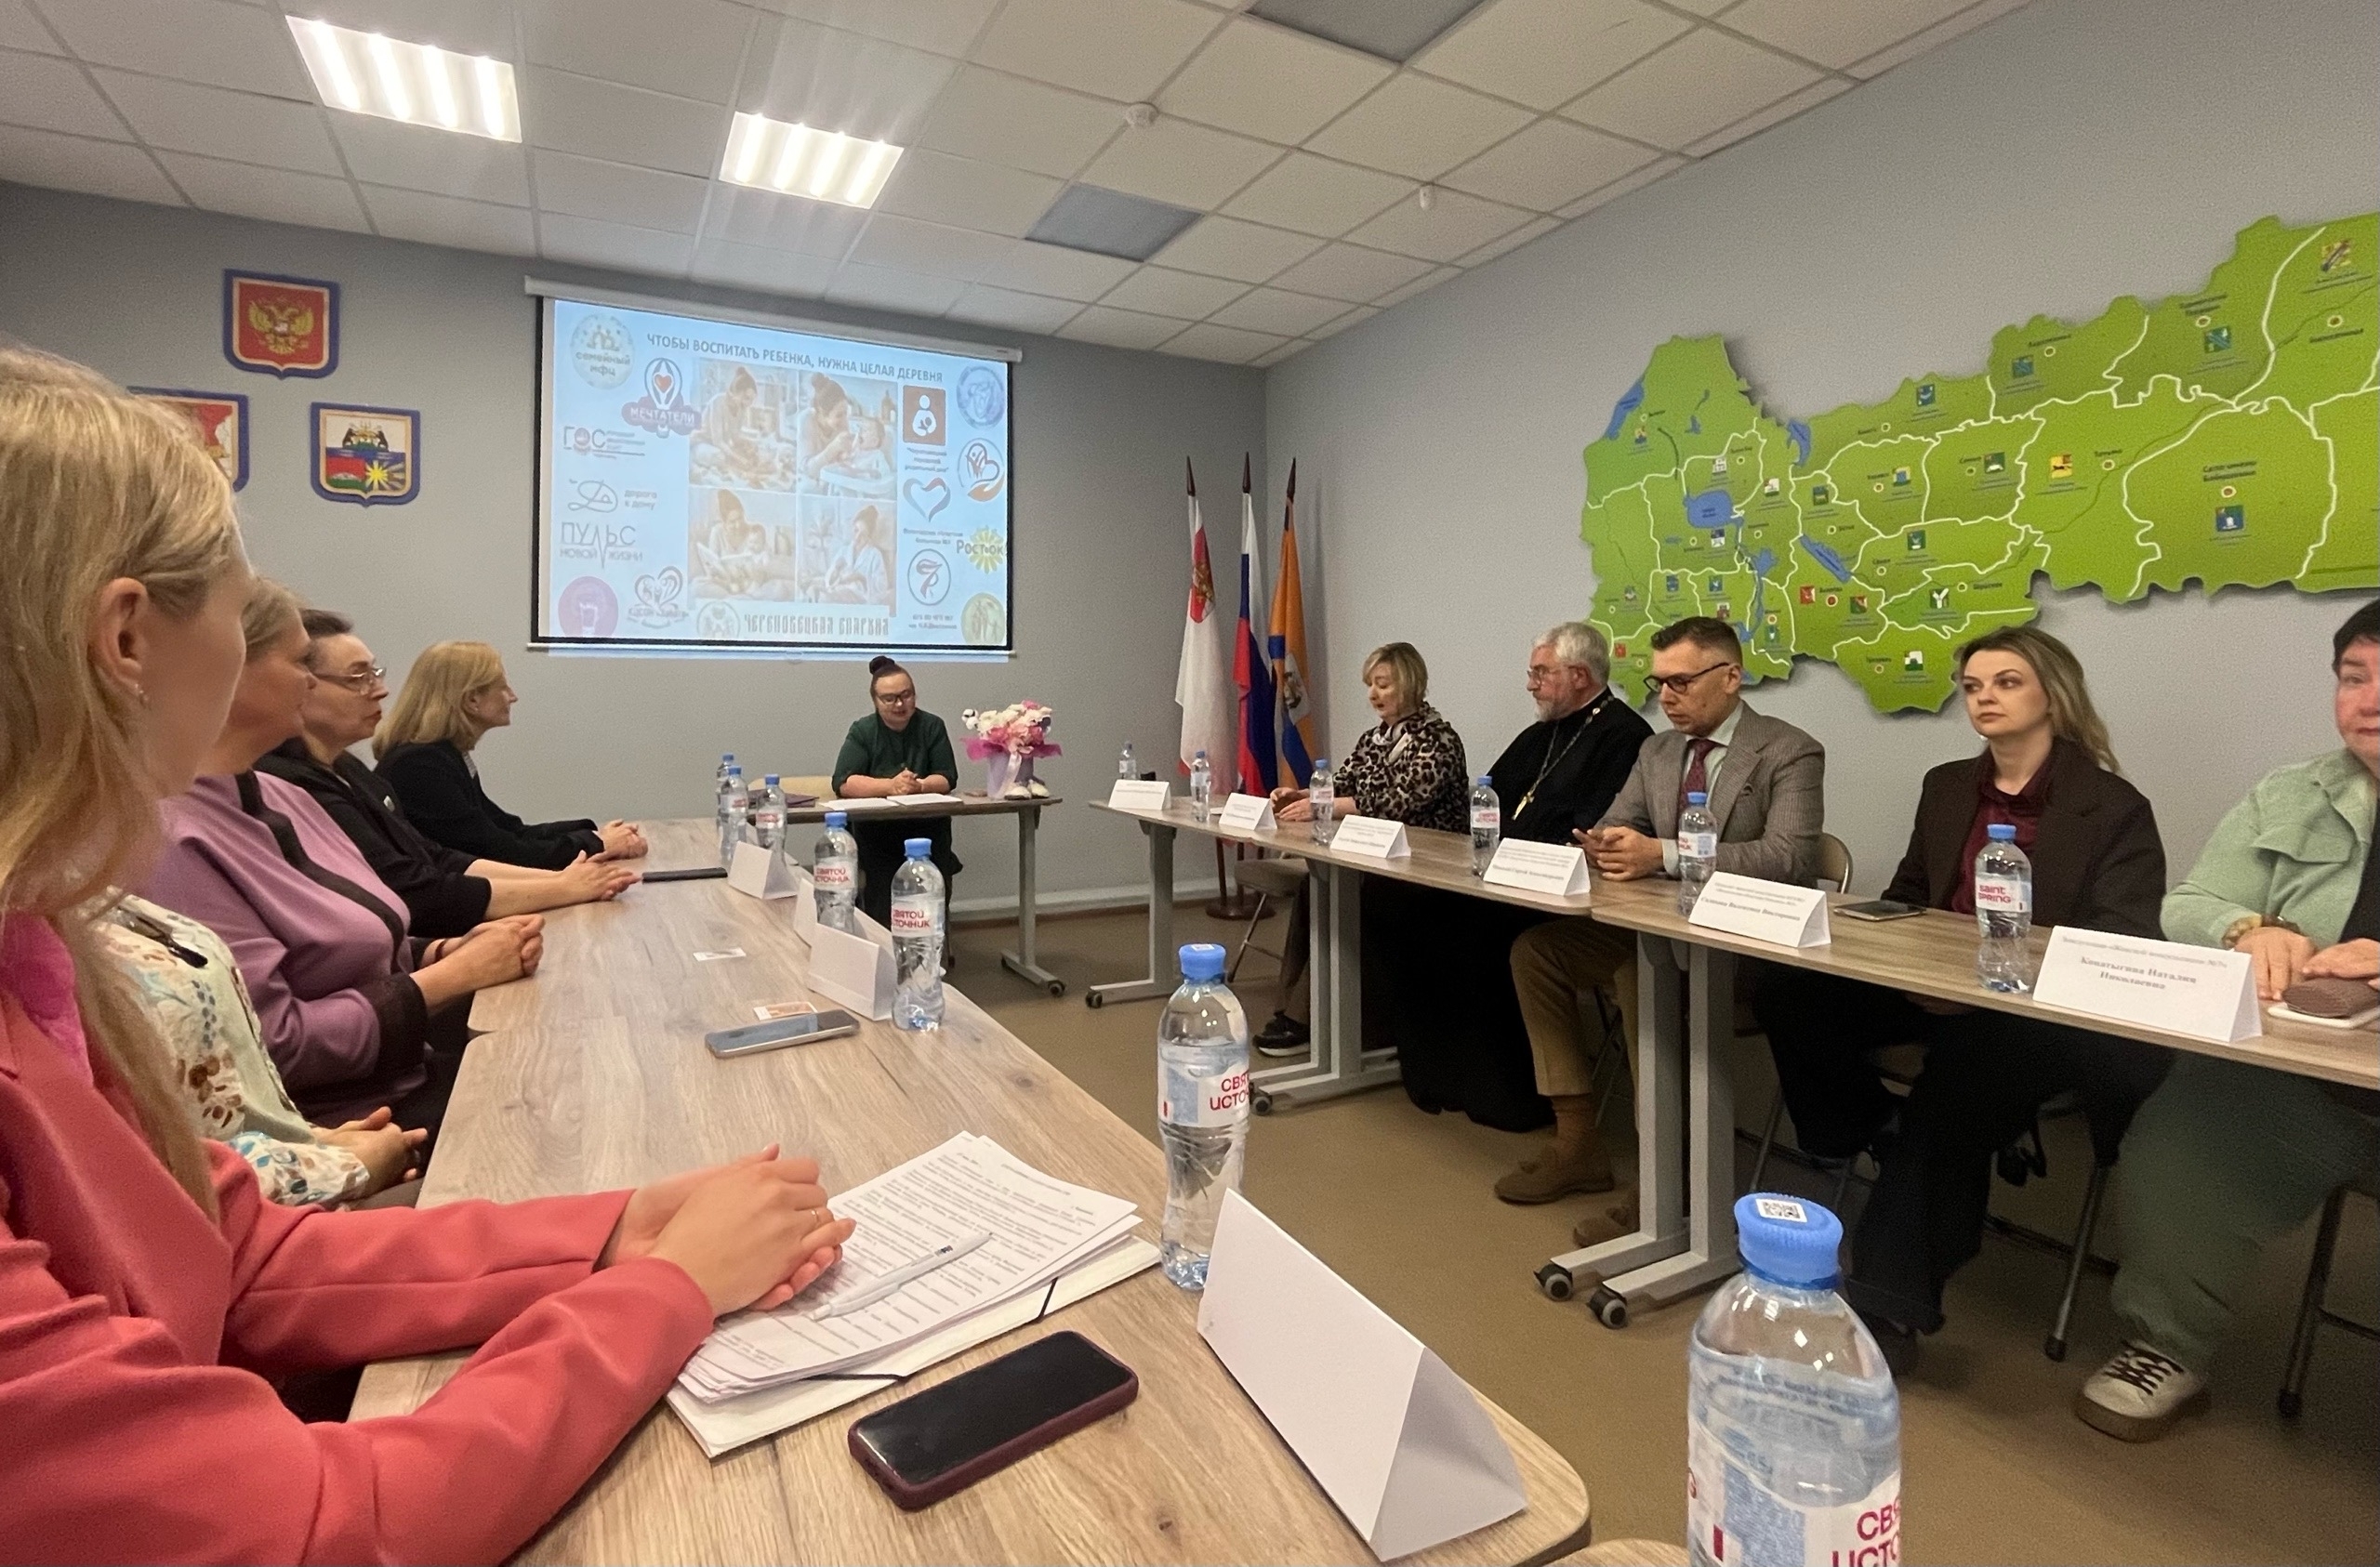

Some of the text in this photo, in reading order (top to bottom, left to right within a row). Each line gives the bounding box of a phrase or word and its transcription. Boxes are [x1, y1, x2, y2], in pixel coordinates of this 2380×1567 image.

[647, 333, 943, 383] ЧТОБЫ ВОСПИТАТЬ РЕБЕНКА, НУЖНА ЦЕЛАЯ ДЕРЕВНЯ
[629, 407, 695, 423] МЕЧТАТЕЛИ
